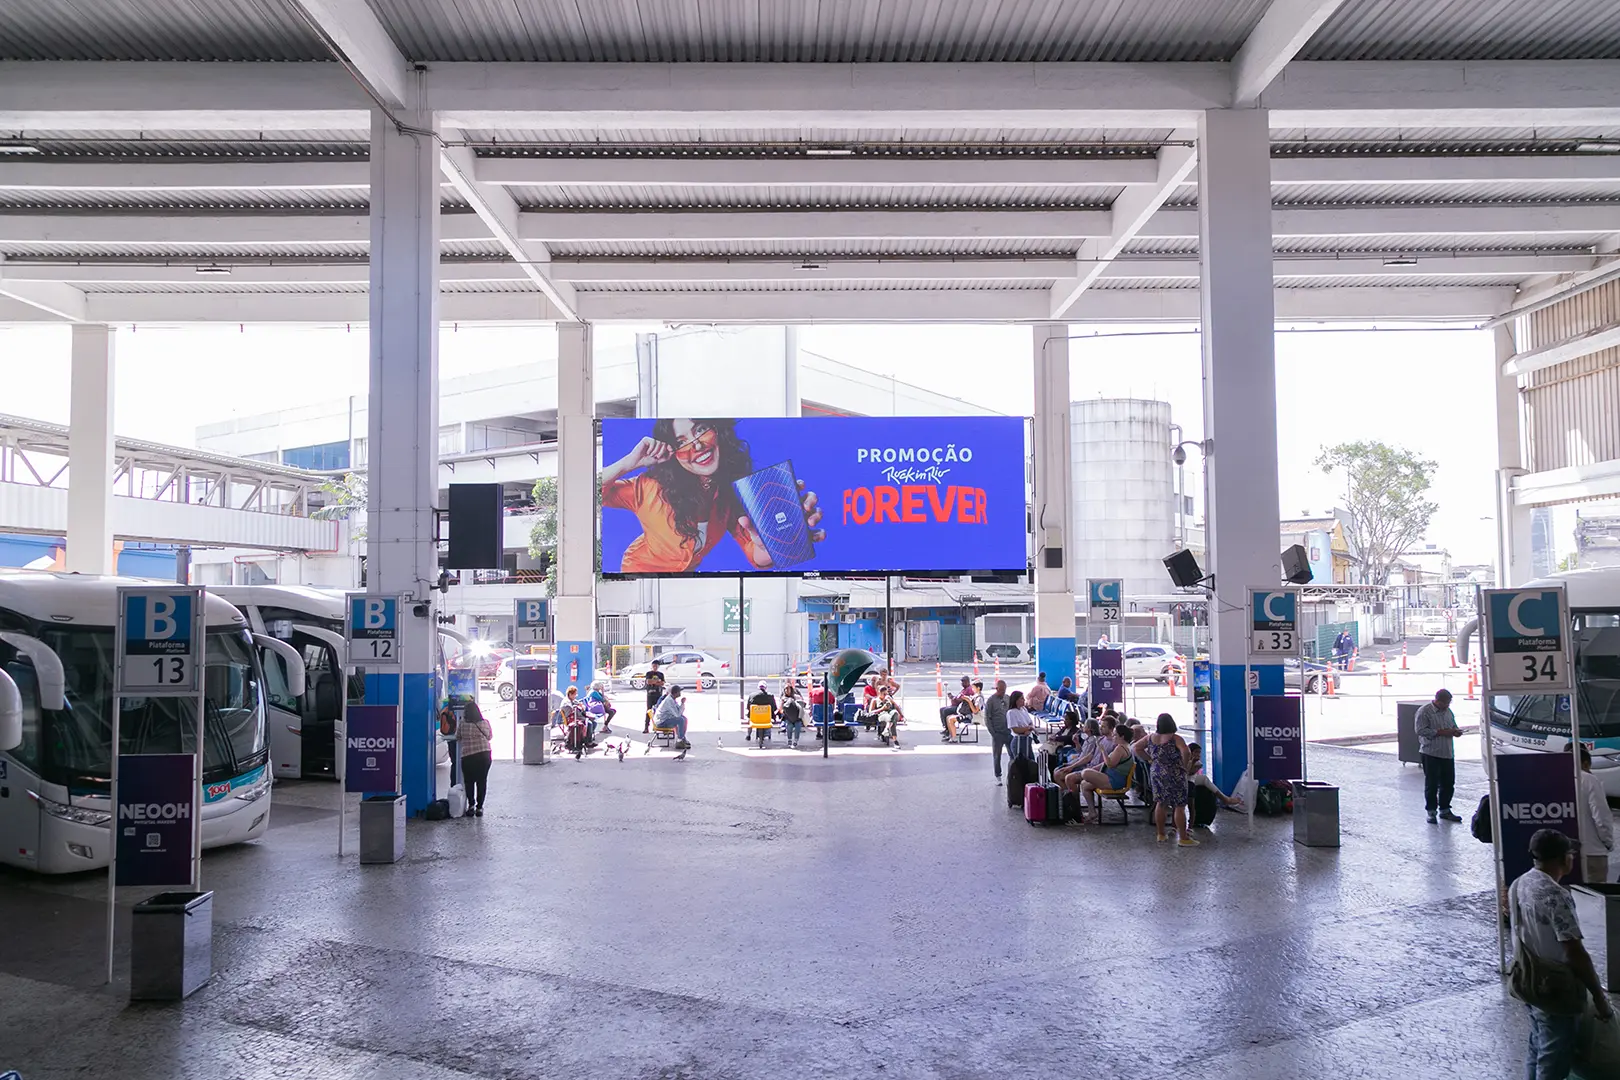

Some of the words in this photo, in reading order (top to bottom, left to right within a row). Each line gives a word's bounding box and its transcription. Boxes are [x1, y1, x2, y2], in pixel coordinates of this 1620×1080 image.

[857, 443, 973, 466] PROMOÇÃO
[881, 466, 916, 484] Rock
[925, 466, 950, 484] Rio
[843, 484, 988, 525] FOREVER
[1097, 582, 1113, 601] C
[364, 599, 387, 629] B
[526, 601, 541, 621] B
[1103, 608, 1118, 620] 32
[1263, 592, 1286, 621] C
[1508, 592, 1545, 637] C
[145, 595, 177, 640] B
[532, 628, 545, 640] 11
[1271, 632, 1292, 650] 33
[1518, 638, 1556, 646] Plataforma
[148, 641, 186, 649] Plataforma
[370, 640, 392, 658] 12
[153, 657, 185, 684] 13
[1092, 669, 1122, 677] NEOOH
[1522, 654, 1557, 682] 34
[517, 689, 548, 697] NEOOH
[1254, 726, 1300, 738] NEOOH
[348, 737, 395, 749] NEOOH
[207, 781, 231, 799] 1001
[119, 803, 190, 820] NEOOH
[1502, 802, 1576, 820] NEOOH
